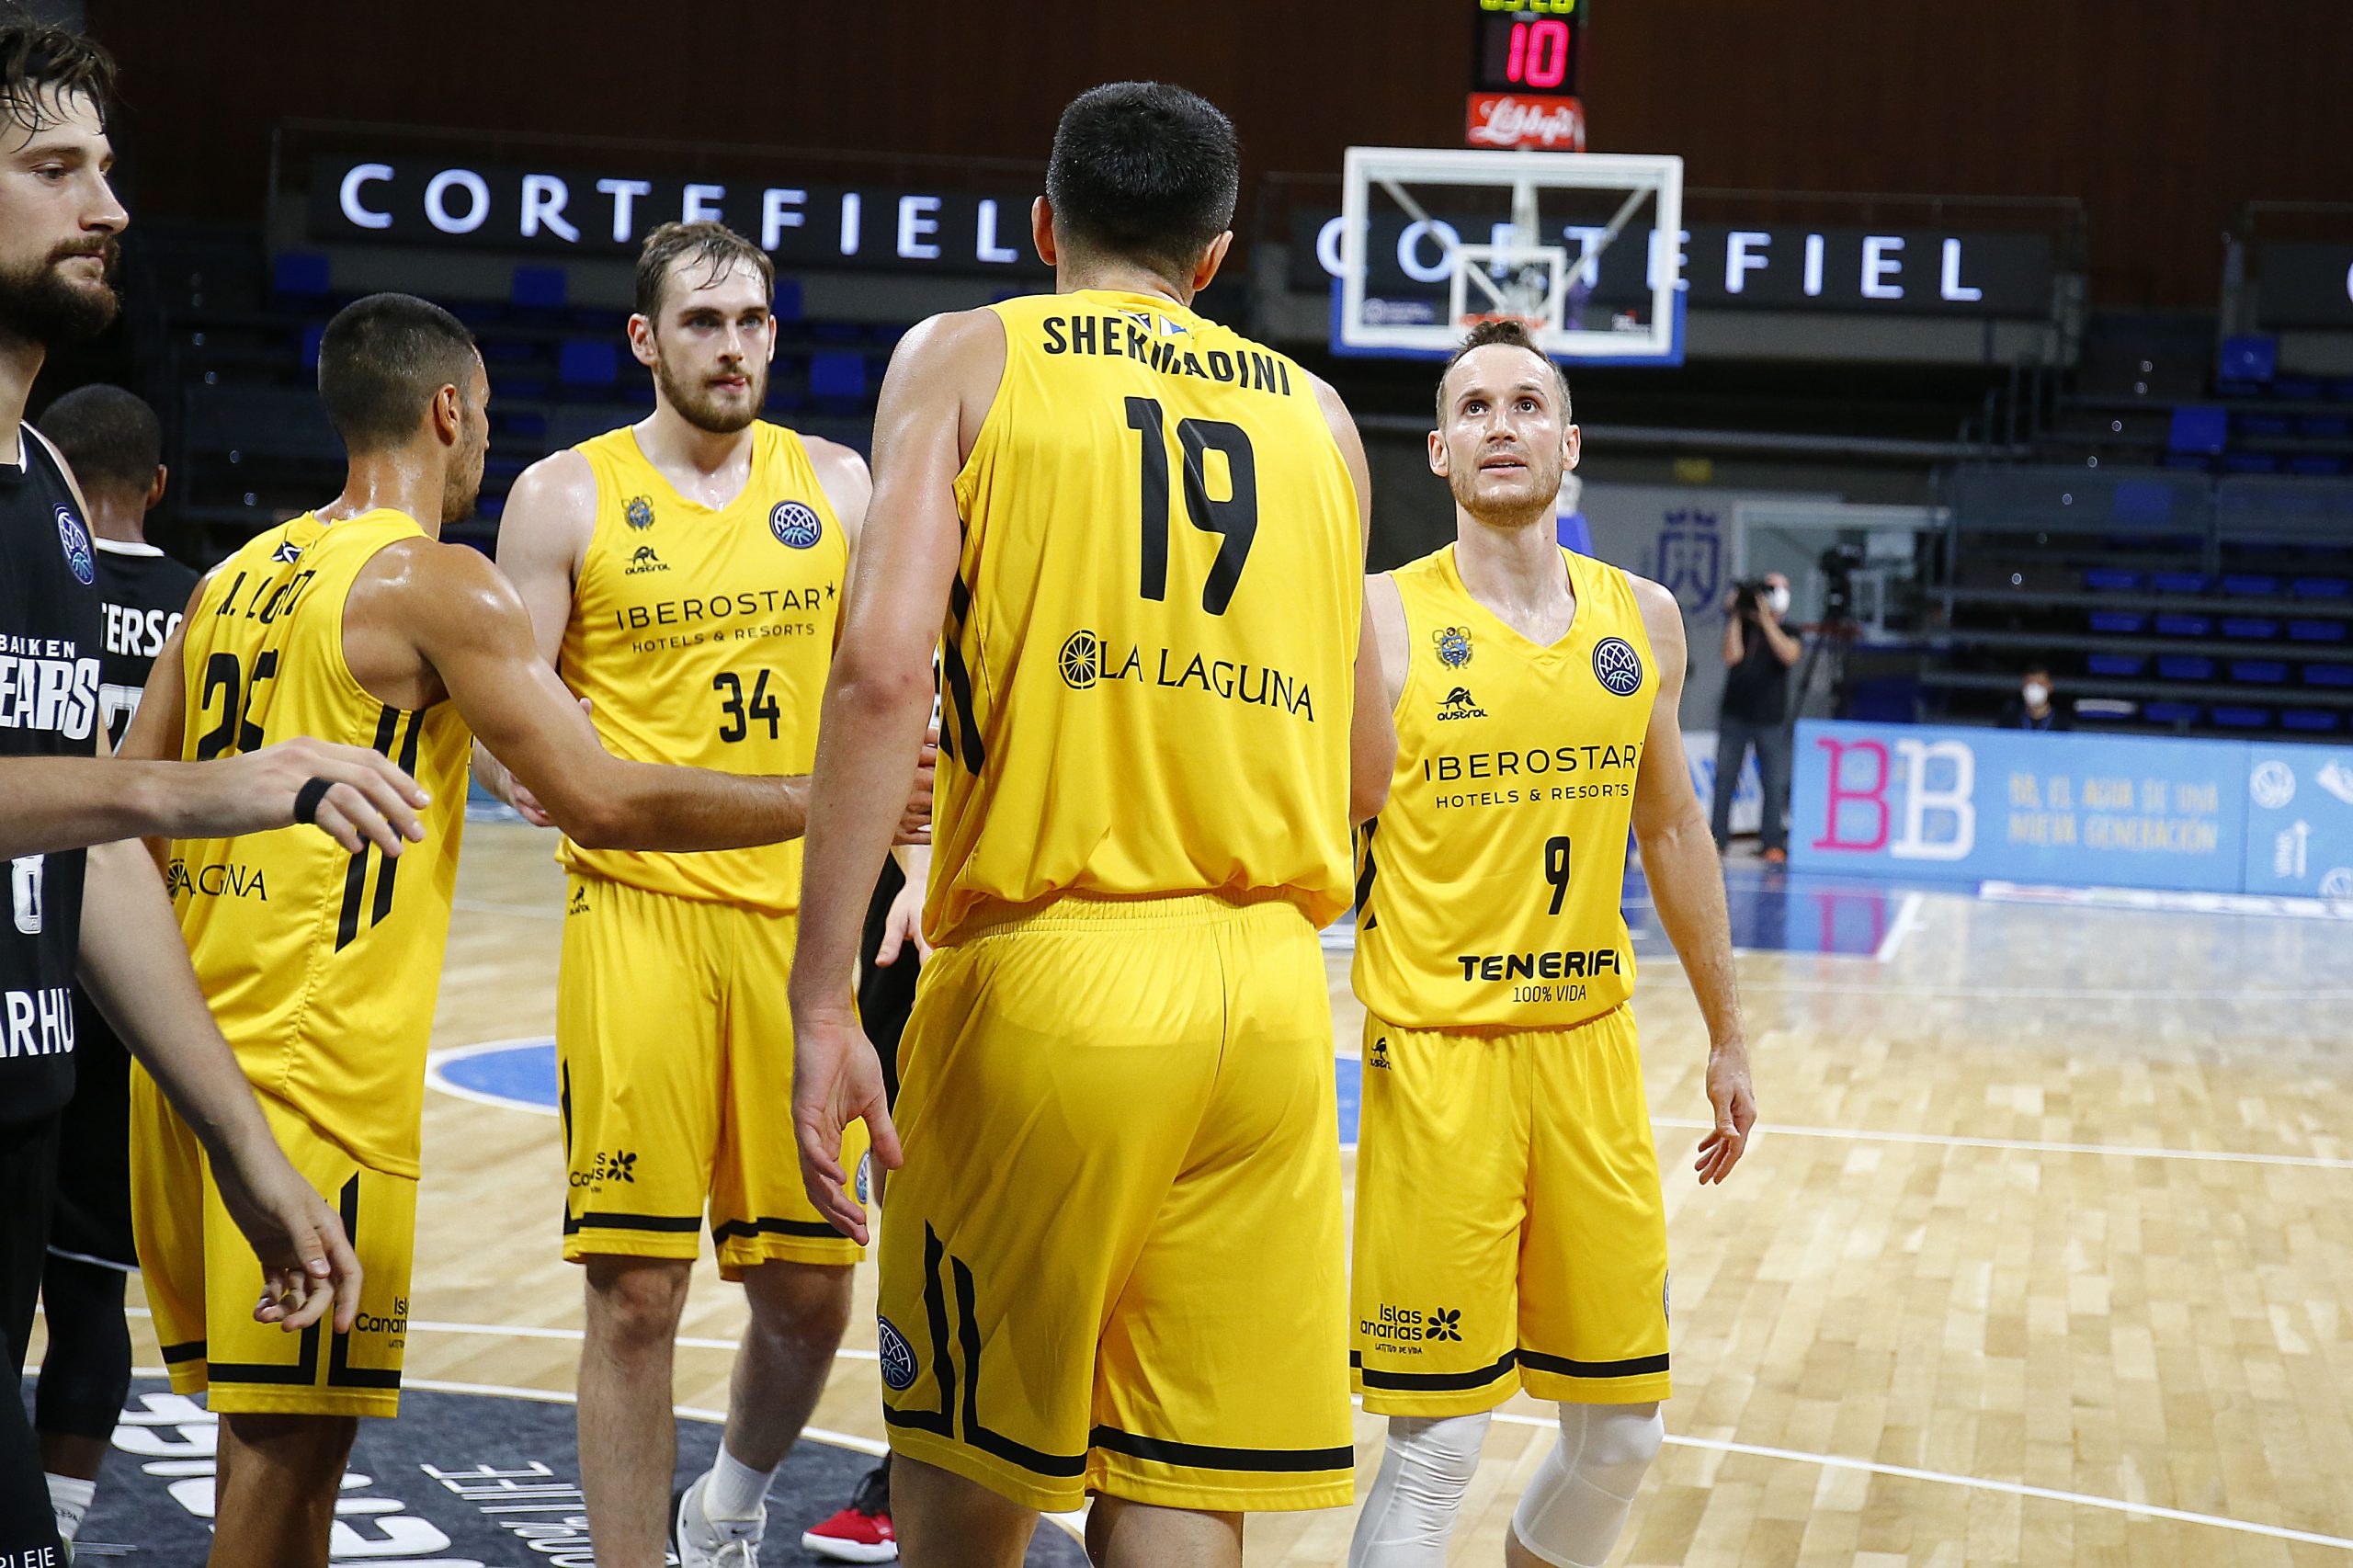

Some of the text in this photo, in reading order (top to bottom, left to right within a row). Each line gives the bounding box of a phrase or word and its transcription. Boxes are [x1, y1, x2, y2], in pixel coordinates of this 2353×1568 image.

[1506, 19, 1570, 87] 10
[340, 163, 1018, 264] CORTEFIEL
[1124, 396, 1258, 616] 19
[616, 588, 821, 631] IBEROSTAR
[632, 623, 815, 653] HOTELS & RESORTS
[712, 669, 780, 743] 34
[1098, 641, 1314, 722] LA LAGUNA
[1424, 744, 1636, 781] IBEROSTAR
[1436, 784, 1629, 809] HOTELS & RESORTS
[1811, 738, 1976, 861] BB
[1544, 835, 1570, 915] 9
[1512, 984, 1586, 1003] 100% VIDA
[1360, 1319, 1422, 1341] anarias
[1380, 1303, 1422, 1324] Islas
